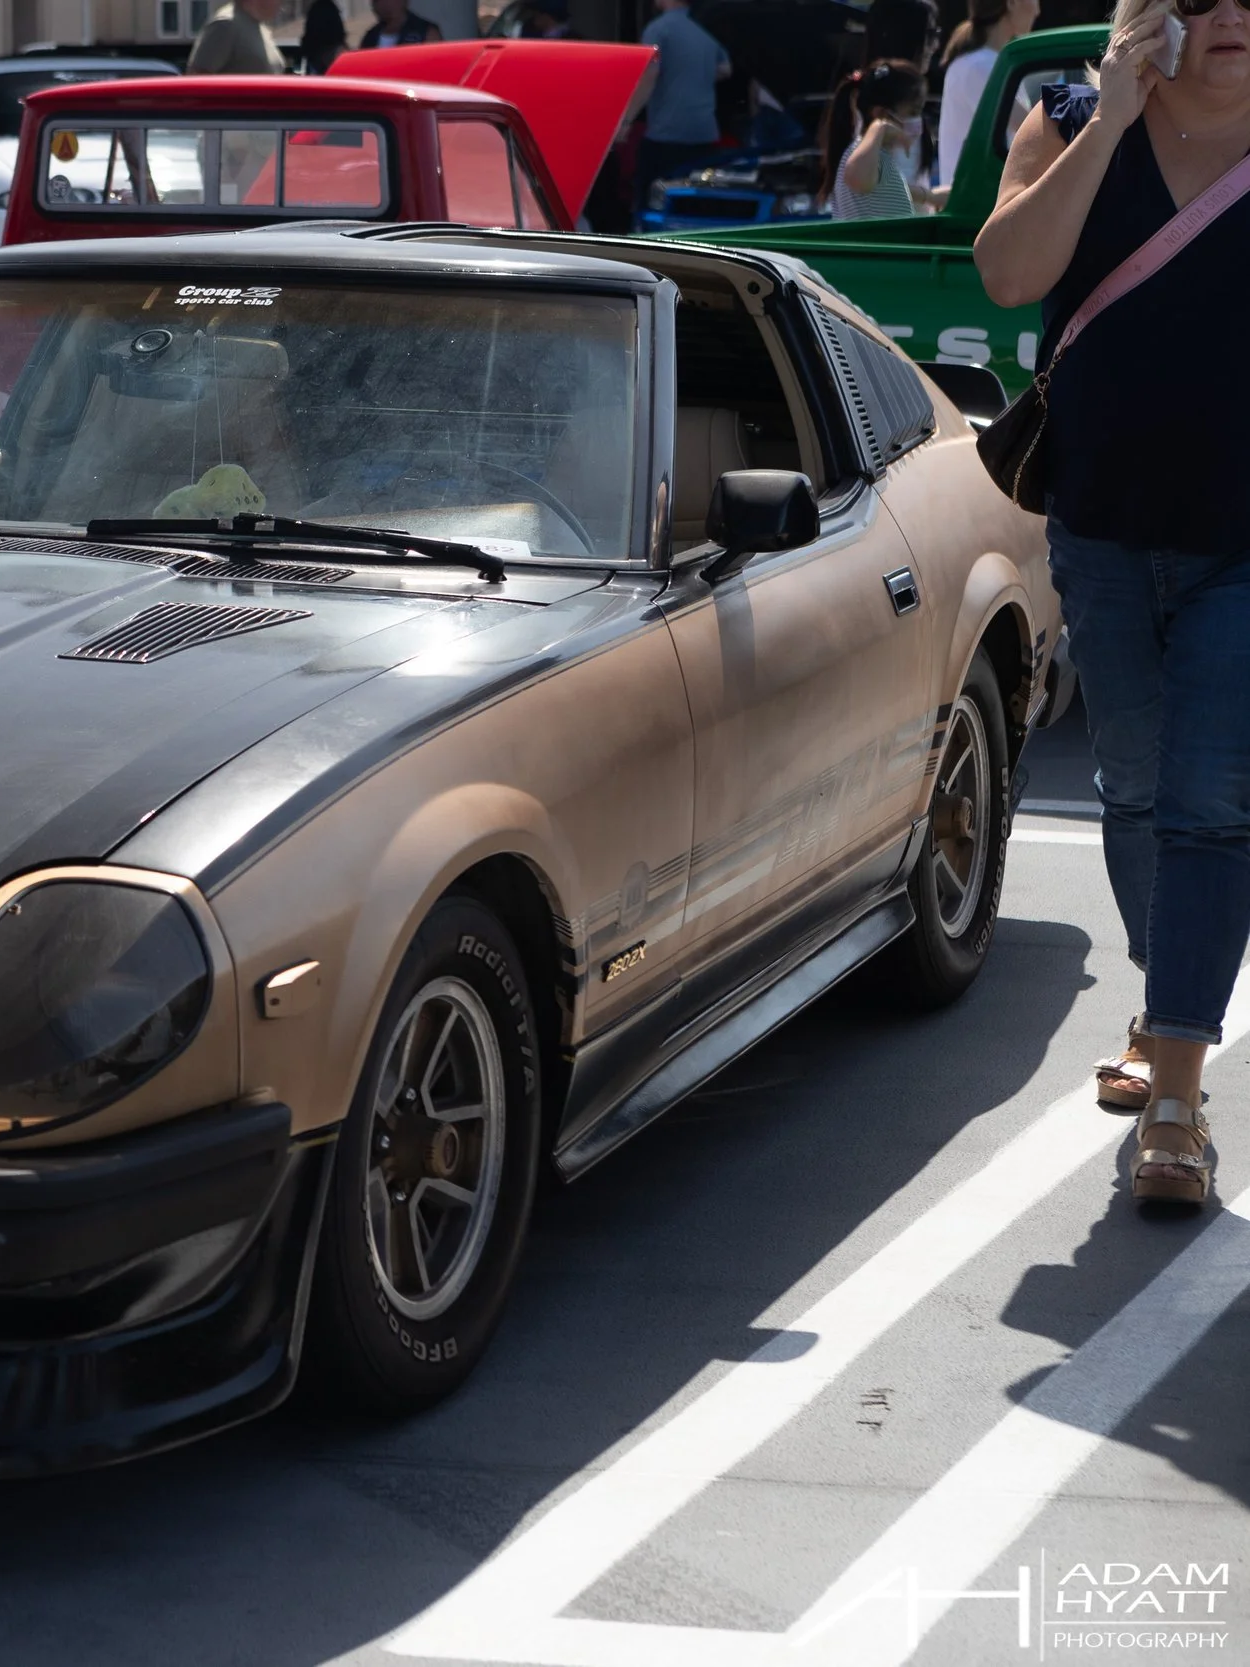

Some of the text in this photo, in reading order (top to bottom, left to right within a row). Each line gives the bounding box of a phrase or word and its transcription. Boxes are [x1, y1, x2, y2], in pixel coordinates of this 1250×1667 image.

[1163, 183, 1236, 248] LOUIS VUITTON
[174, 297, 274, 306] sports car club
[178, 285, 242, 299] Group
[605, 943, 647, 982] 280ZX
